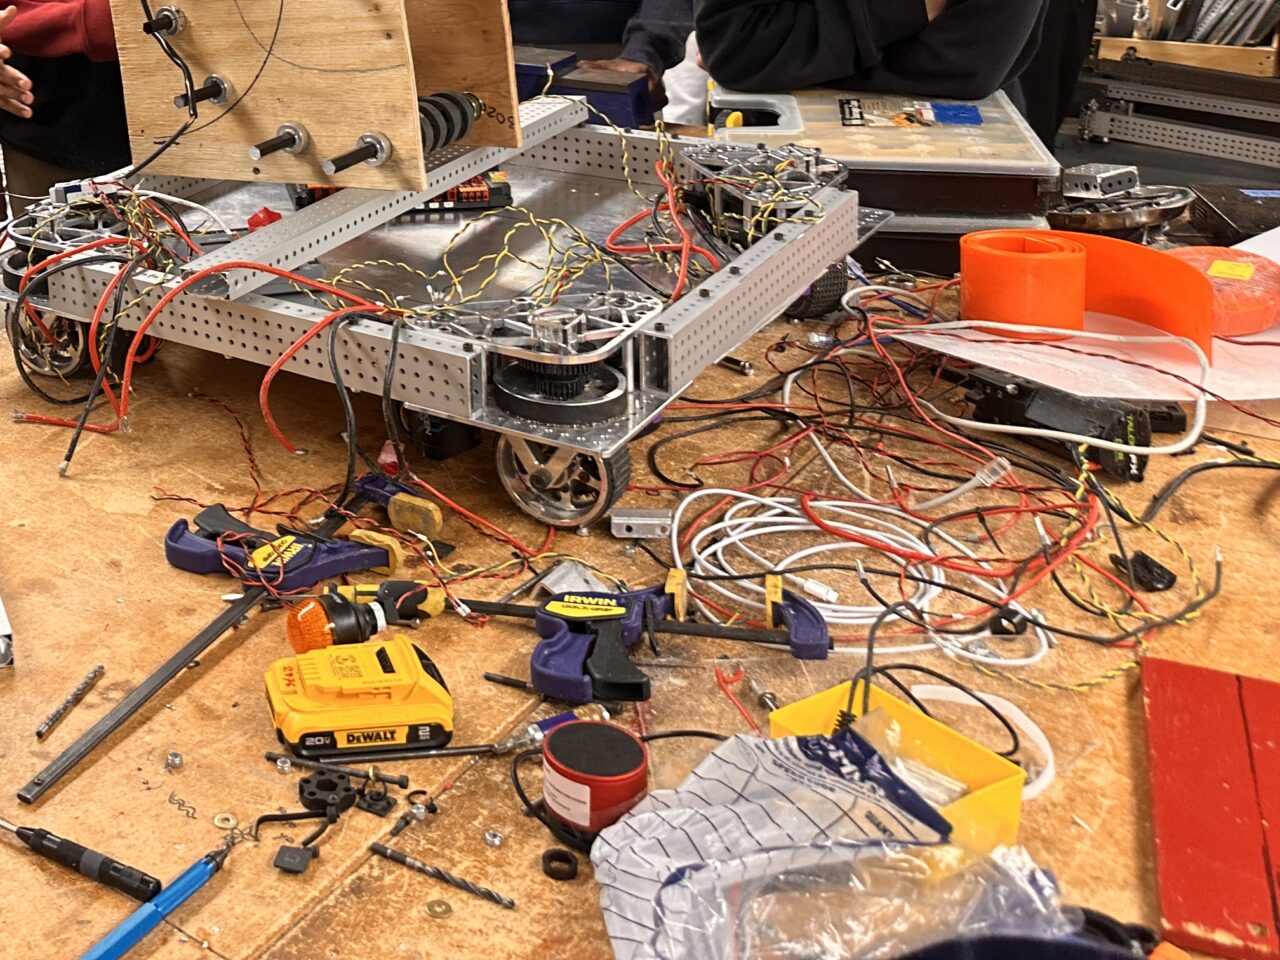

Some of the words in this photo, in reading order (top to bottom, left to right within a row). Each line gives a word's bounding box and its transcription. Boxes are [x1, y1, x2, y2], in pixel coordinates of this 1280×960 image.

[563, 594, 617, 607] IRWIN
[346, 730, 396, 744] DeWALT
[418, 726, 430, 735] 2
